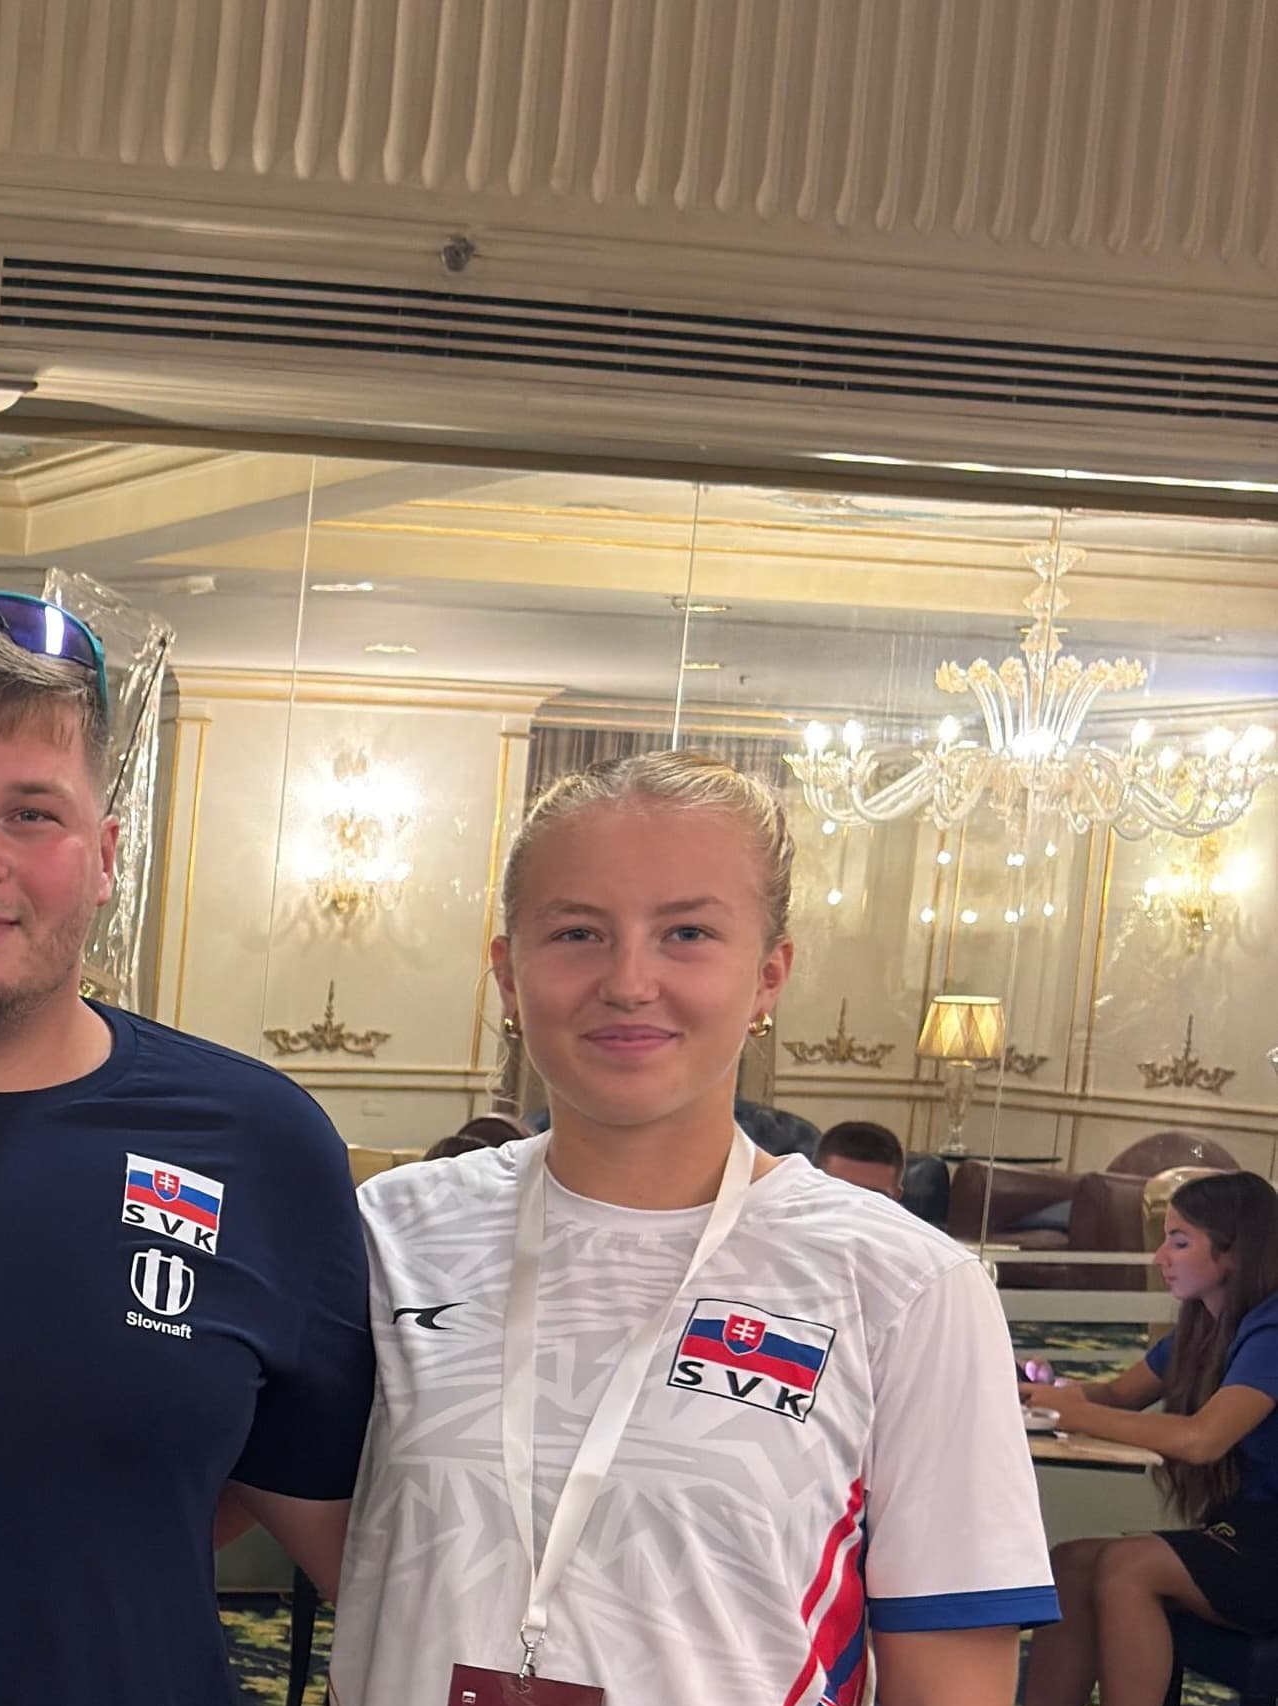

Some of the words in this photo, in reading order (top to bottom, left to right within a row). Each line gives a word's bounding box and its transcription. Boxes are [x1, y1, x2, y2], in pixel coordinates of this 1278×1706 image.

[124, 1203, 216, 1252] SVK
[125, 1311, 193, 1339] Slovnaft
[673, 1360, 813, 1418] SVK
